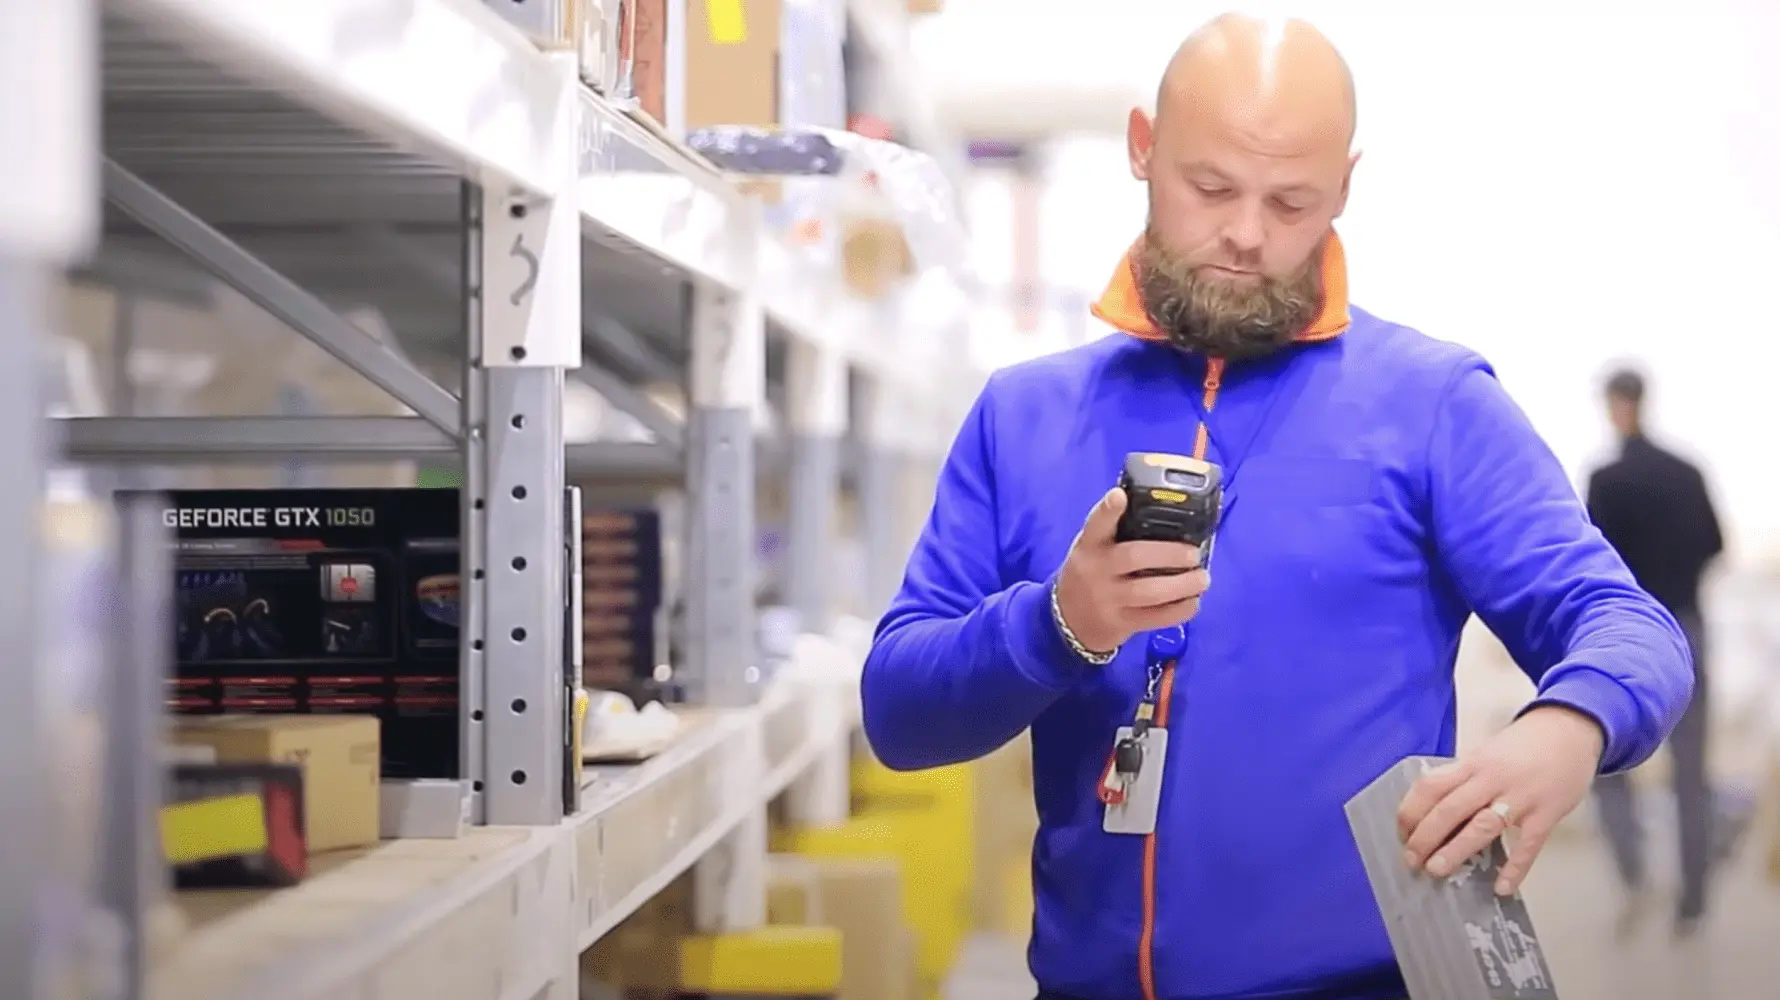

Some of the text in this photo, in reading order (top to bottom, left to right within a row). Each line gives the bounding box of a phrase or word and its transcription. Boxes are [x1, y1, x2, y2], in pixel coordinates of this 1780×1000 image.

[162, 507, 375, 527] GEFORCE GTX 1050
